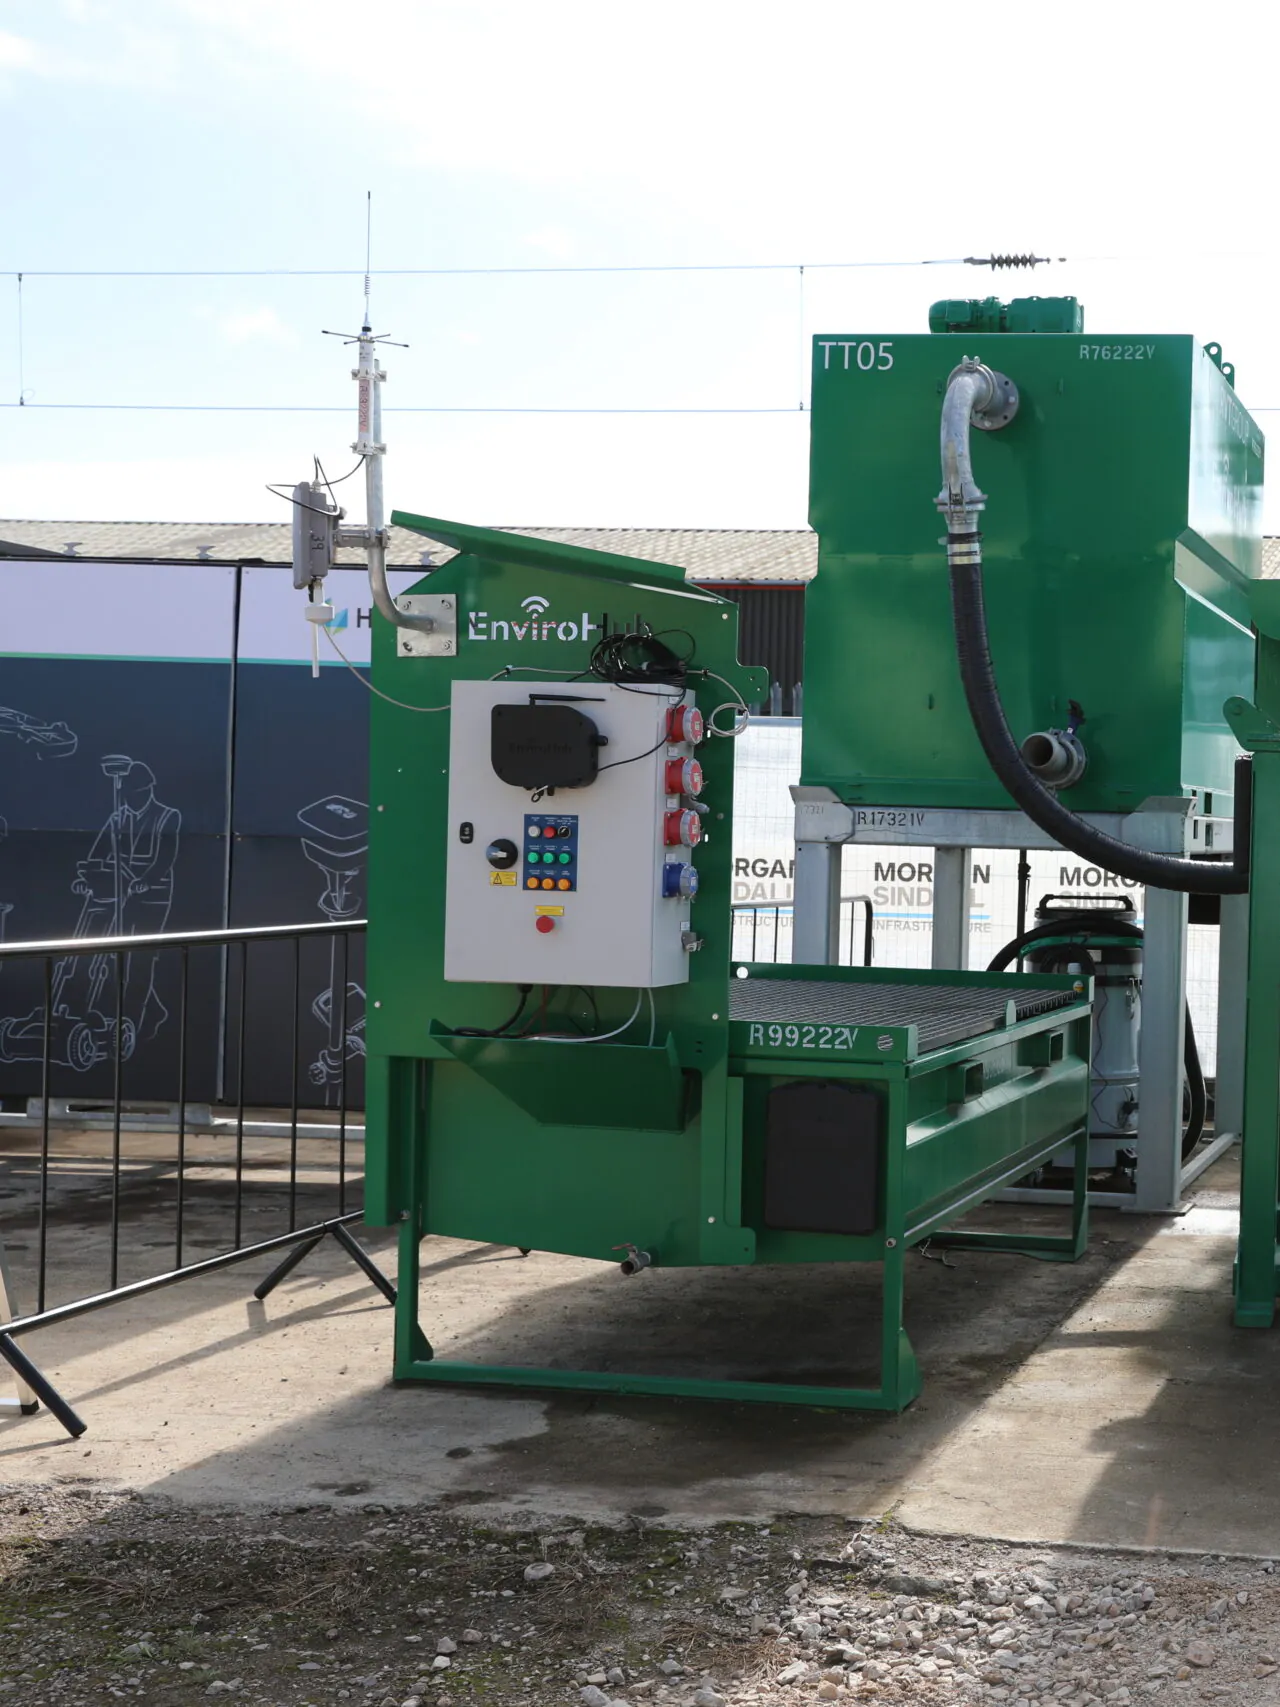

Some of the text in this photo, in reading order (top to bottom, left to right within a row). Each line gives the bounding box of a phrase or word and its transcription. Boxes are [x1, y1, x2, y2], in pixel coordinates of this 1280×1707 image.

[818, 342, 894, 370] TT05
[1079, 344, 1156, 360] R76222V
[857, 811, 925, 827] R17321V
[874, 862, 991, 884] MORN
[872, 886, 985, 907] SINDL
[748, 1023, 858, 1051] R99222V
